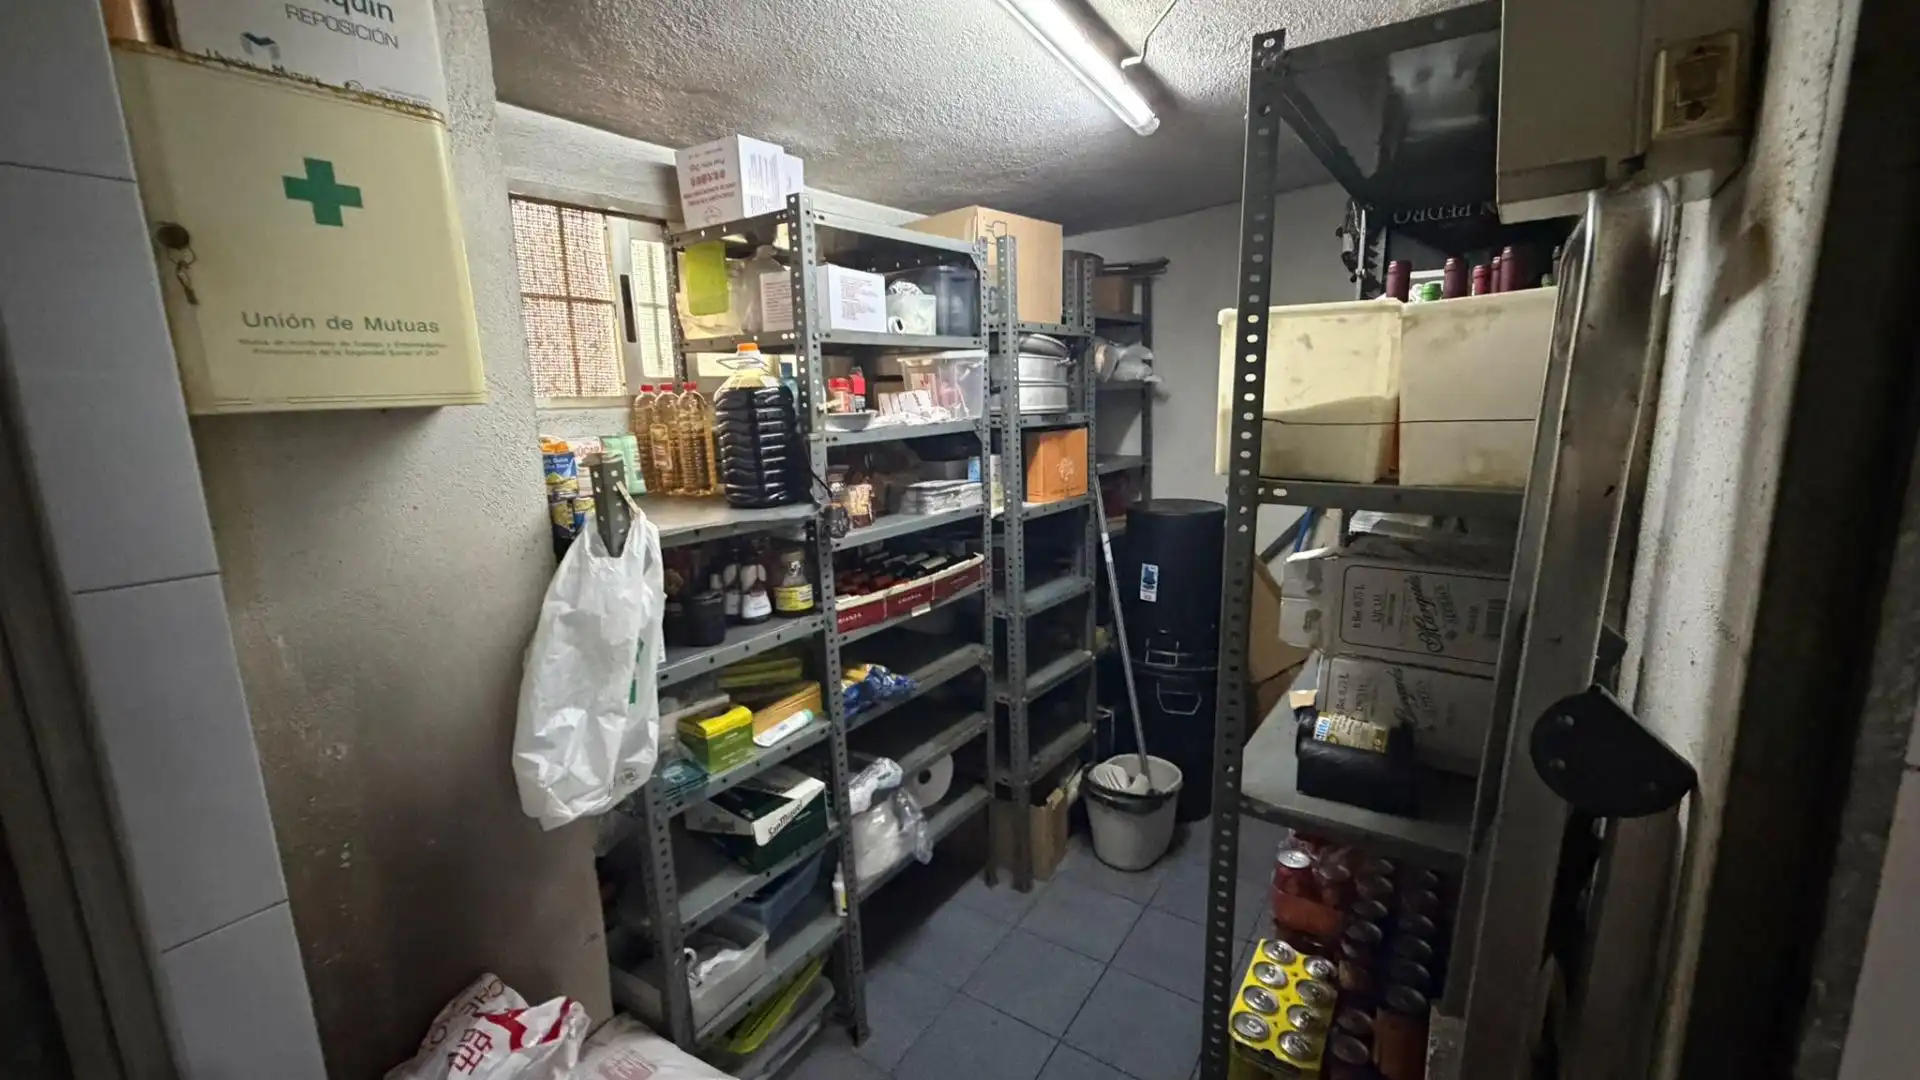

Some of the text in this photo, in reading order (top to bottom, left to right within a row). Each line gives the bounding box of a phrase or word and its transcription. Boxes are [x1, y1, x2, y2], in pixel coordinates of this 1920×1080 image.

[284, 3, 400, 49] REPOSICIÓN
[241, 311, 441, 334] Unión de Mutuas
